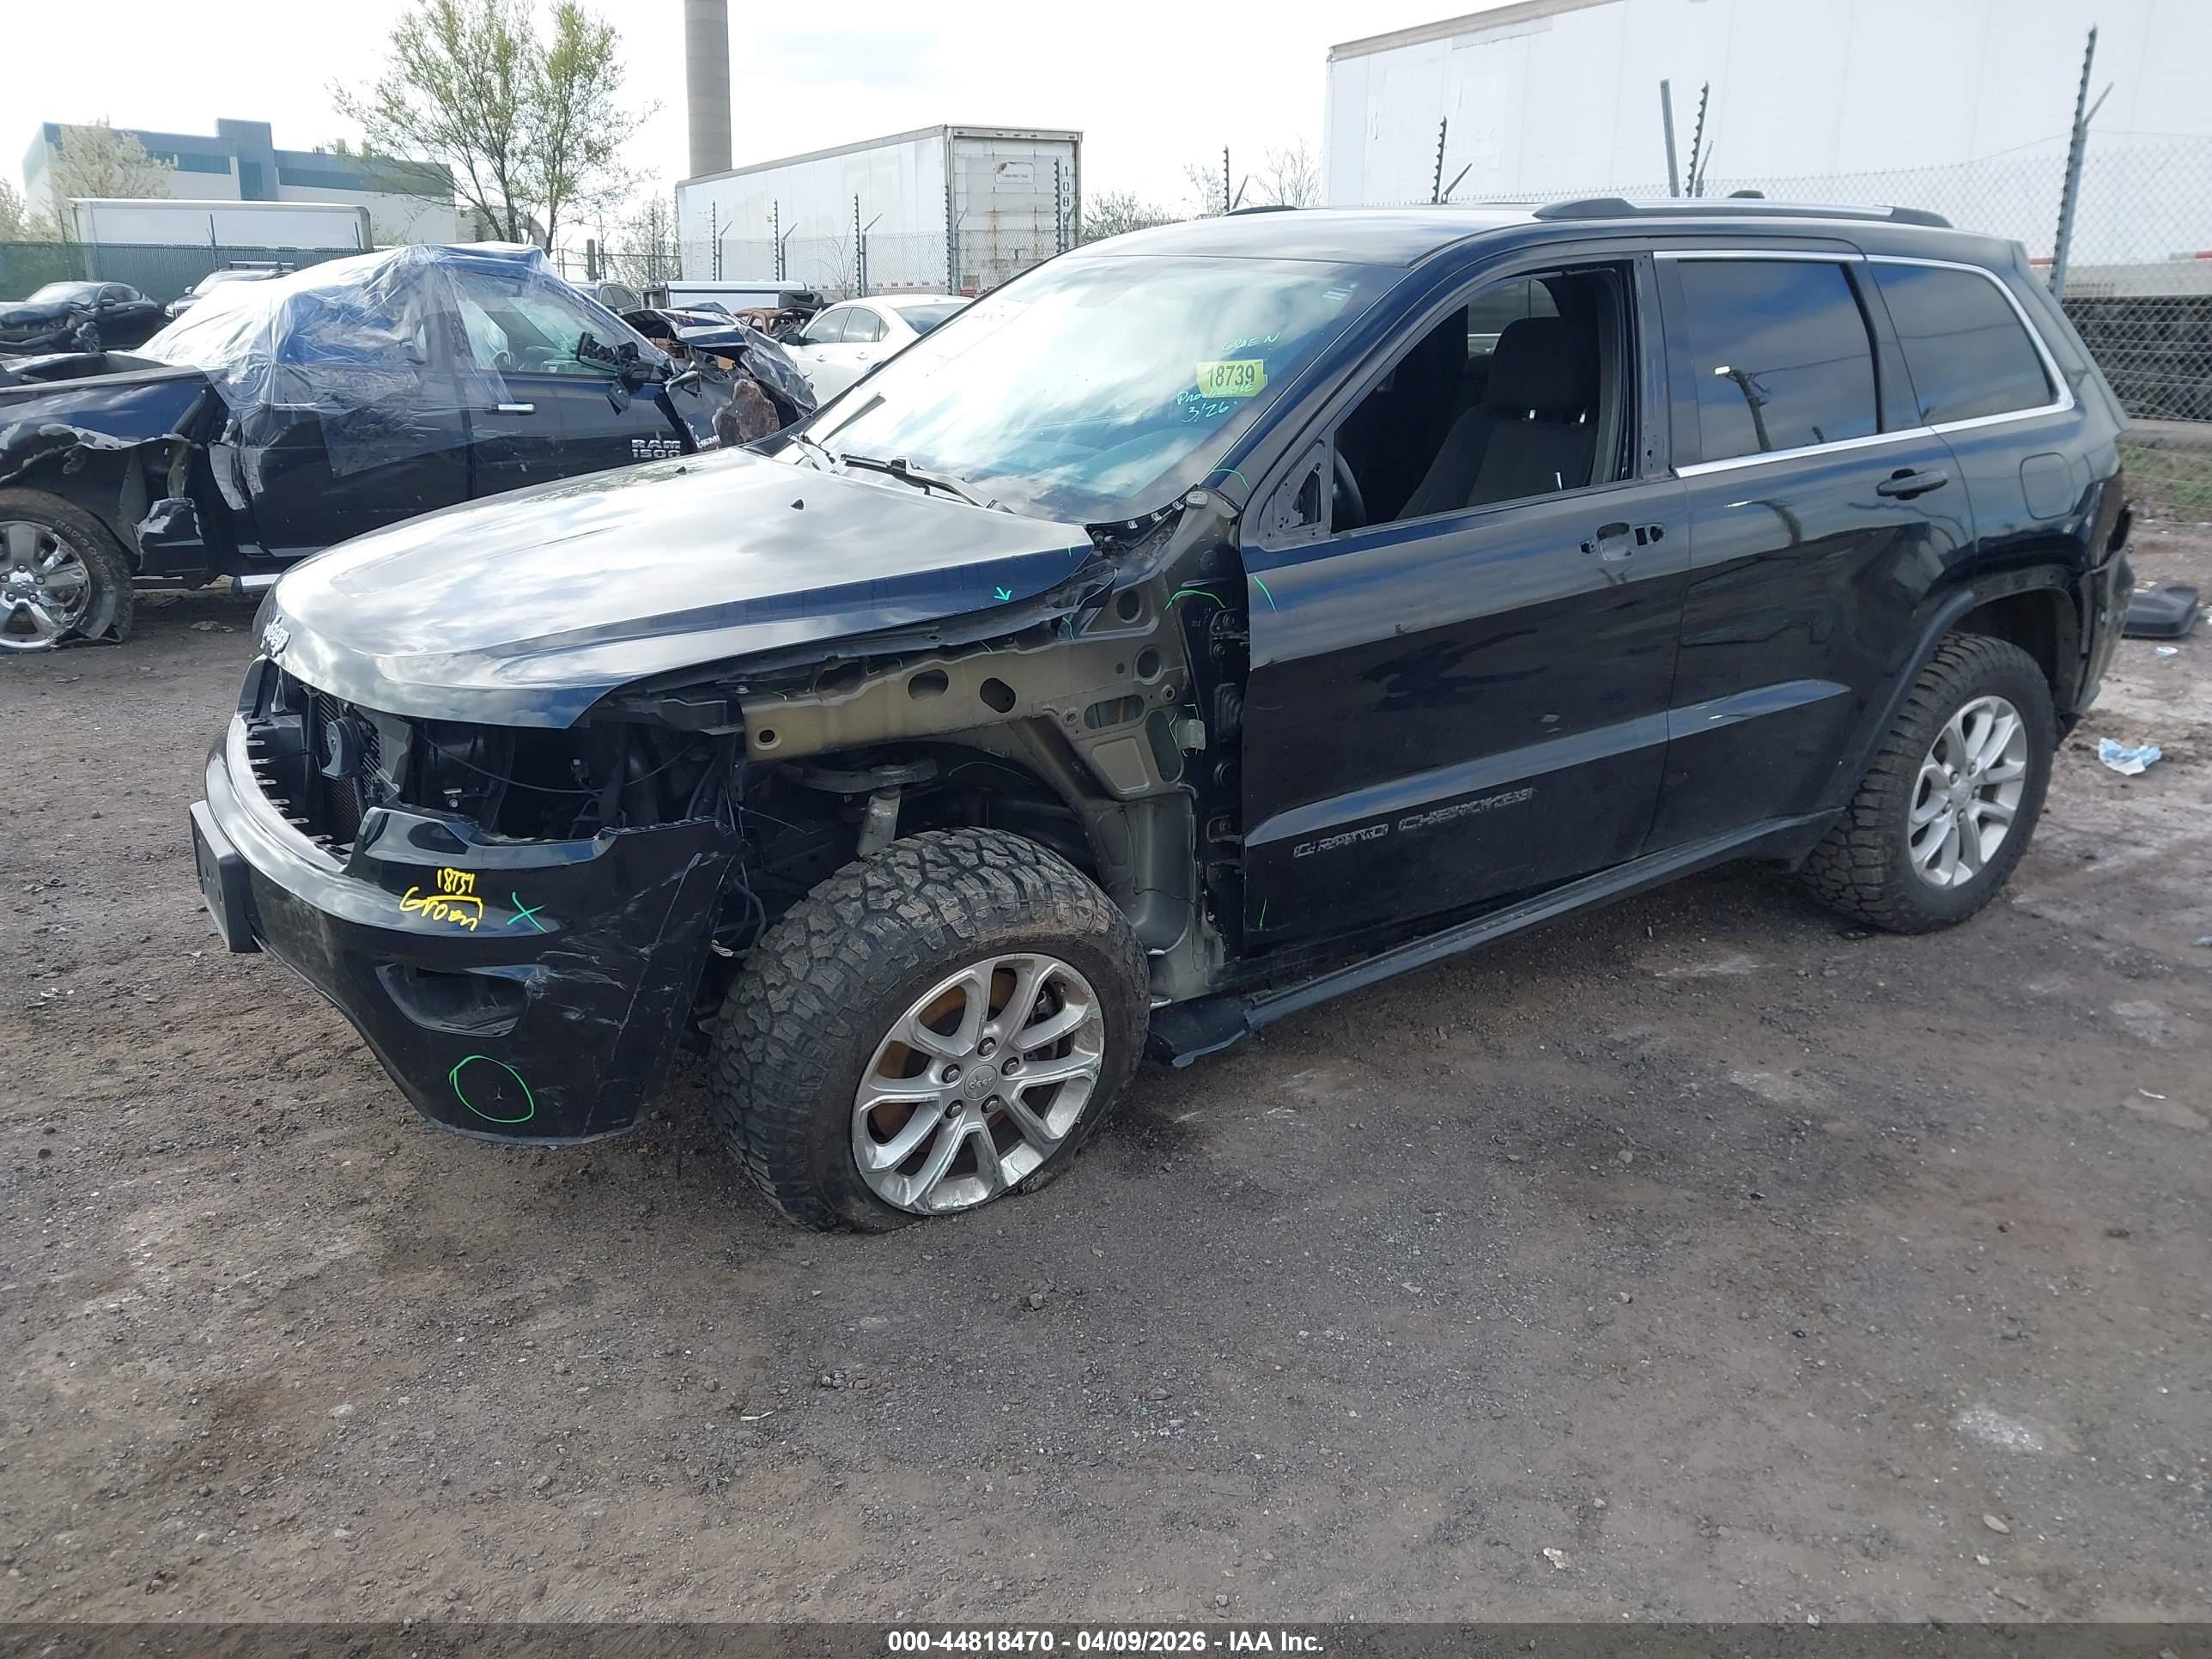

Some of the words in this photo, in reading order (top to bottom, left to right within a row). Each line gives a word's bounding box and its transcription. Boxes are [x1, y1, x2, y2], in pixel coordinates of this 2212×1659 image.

[1206, 364, 1255, 388] 18739
[631, 439, 681, 449] RAM
[696, 434, 720, 448] HEMI
[631, 449, 681, 459] 1500
[1294, 823, 1389, 857] GRAND
